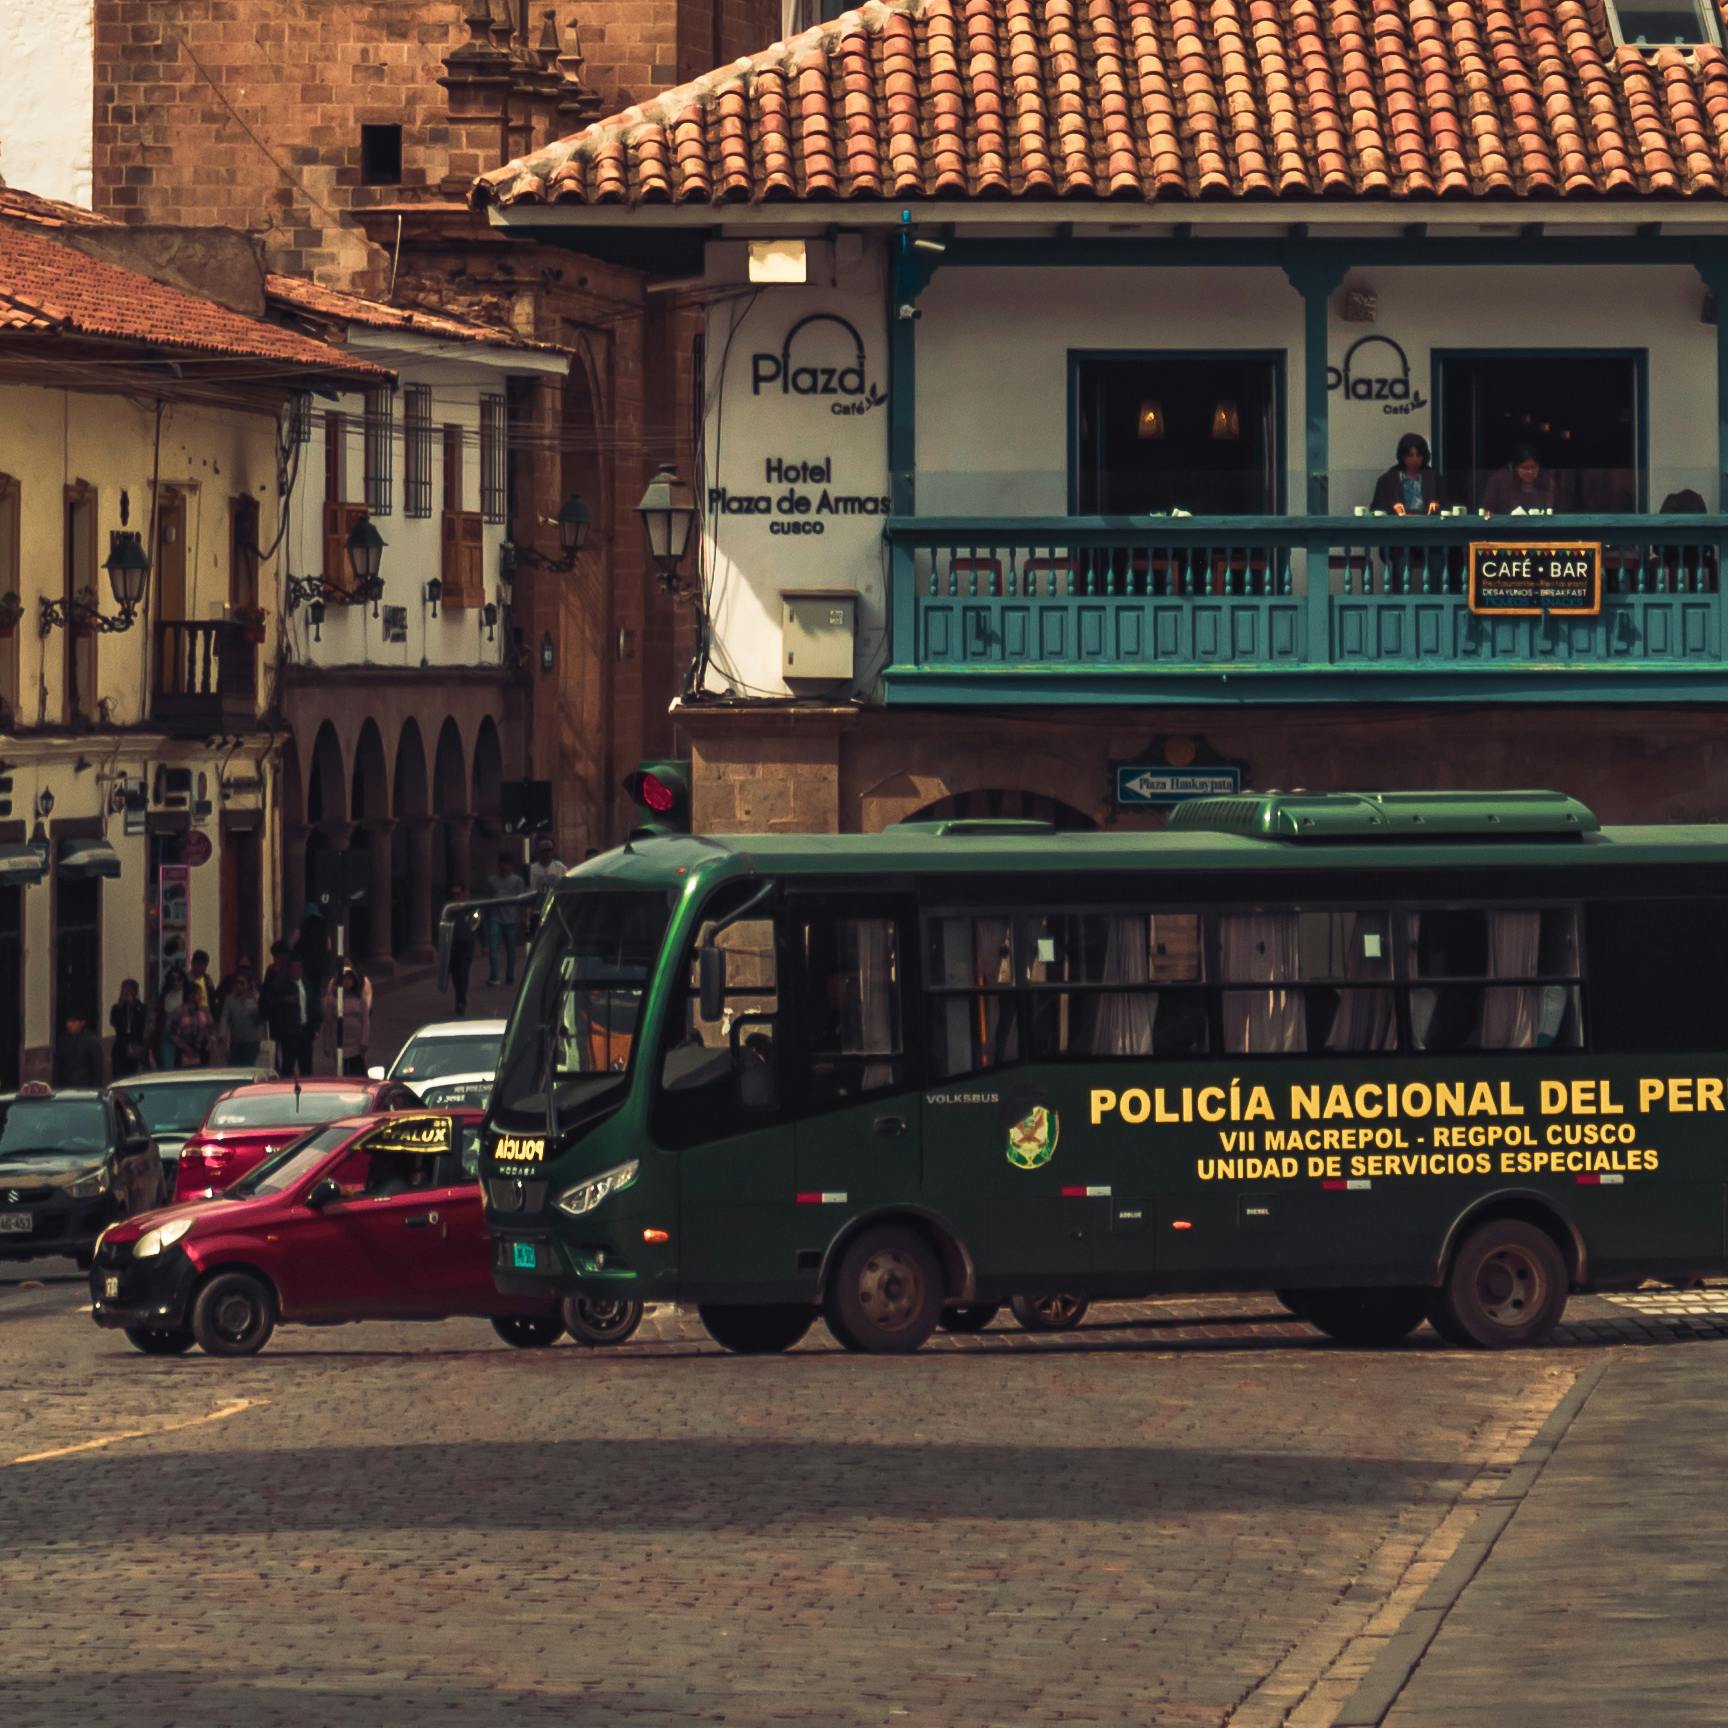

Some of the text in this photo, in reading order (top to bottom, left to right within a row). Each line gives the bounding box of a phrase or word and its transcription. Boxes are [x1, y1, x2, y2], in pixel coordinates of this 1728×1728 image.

[753, 353, 865, 395] Plaza
[831, 403, 865, 415] Café
[1383, 403, 1410, 415] Café
[766, 458, 831, 483] Hotel
[709, 489, 890, 514] Plaza de Armas
[1482, 558, 1588, 578] CAFÉ BAR
[1482, 589, 1533, 597] DESAYUNOS
[1540, 588, 1587, 597] BREAKFAST
[1139, 778, 1166, 790] Plaza
[927, 1092, 1000, 1104] VOLKSBUS
[1090, 1078, 1277, 1125] POLICÍA
[1290, 1081, 1525, 1120] NACIONAL
[1540, 1080, 1624, 1115] DEL
[1219, 1131, 1255, 1153] VII
[1264, 1127, 1410, 1151] MACREPOL
[1433, 1124, 1538, 1149] REGPOL
[1546, 1122, 1637, 1145] CUSCO
[1197, 1149, 1659, 1180] UNIDAD DE SERVICIOS ESPECIALES
